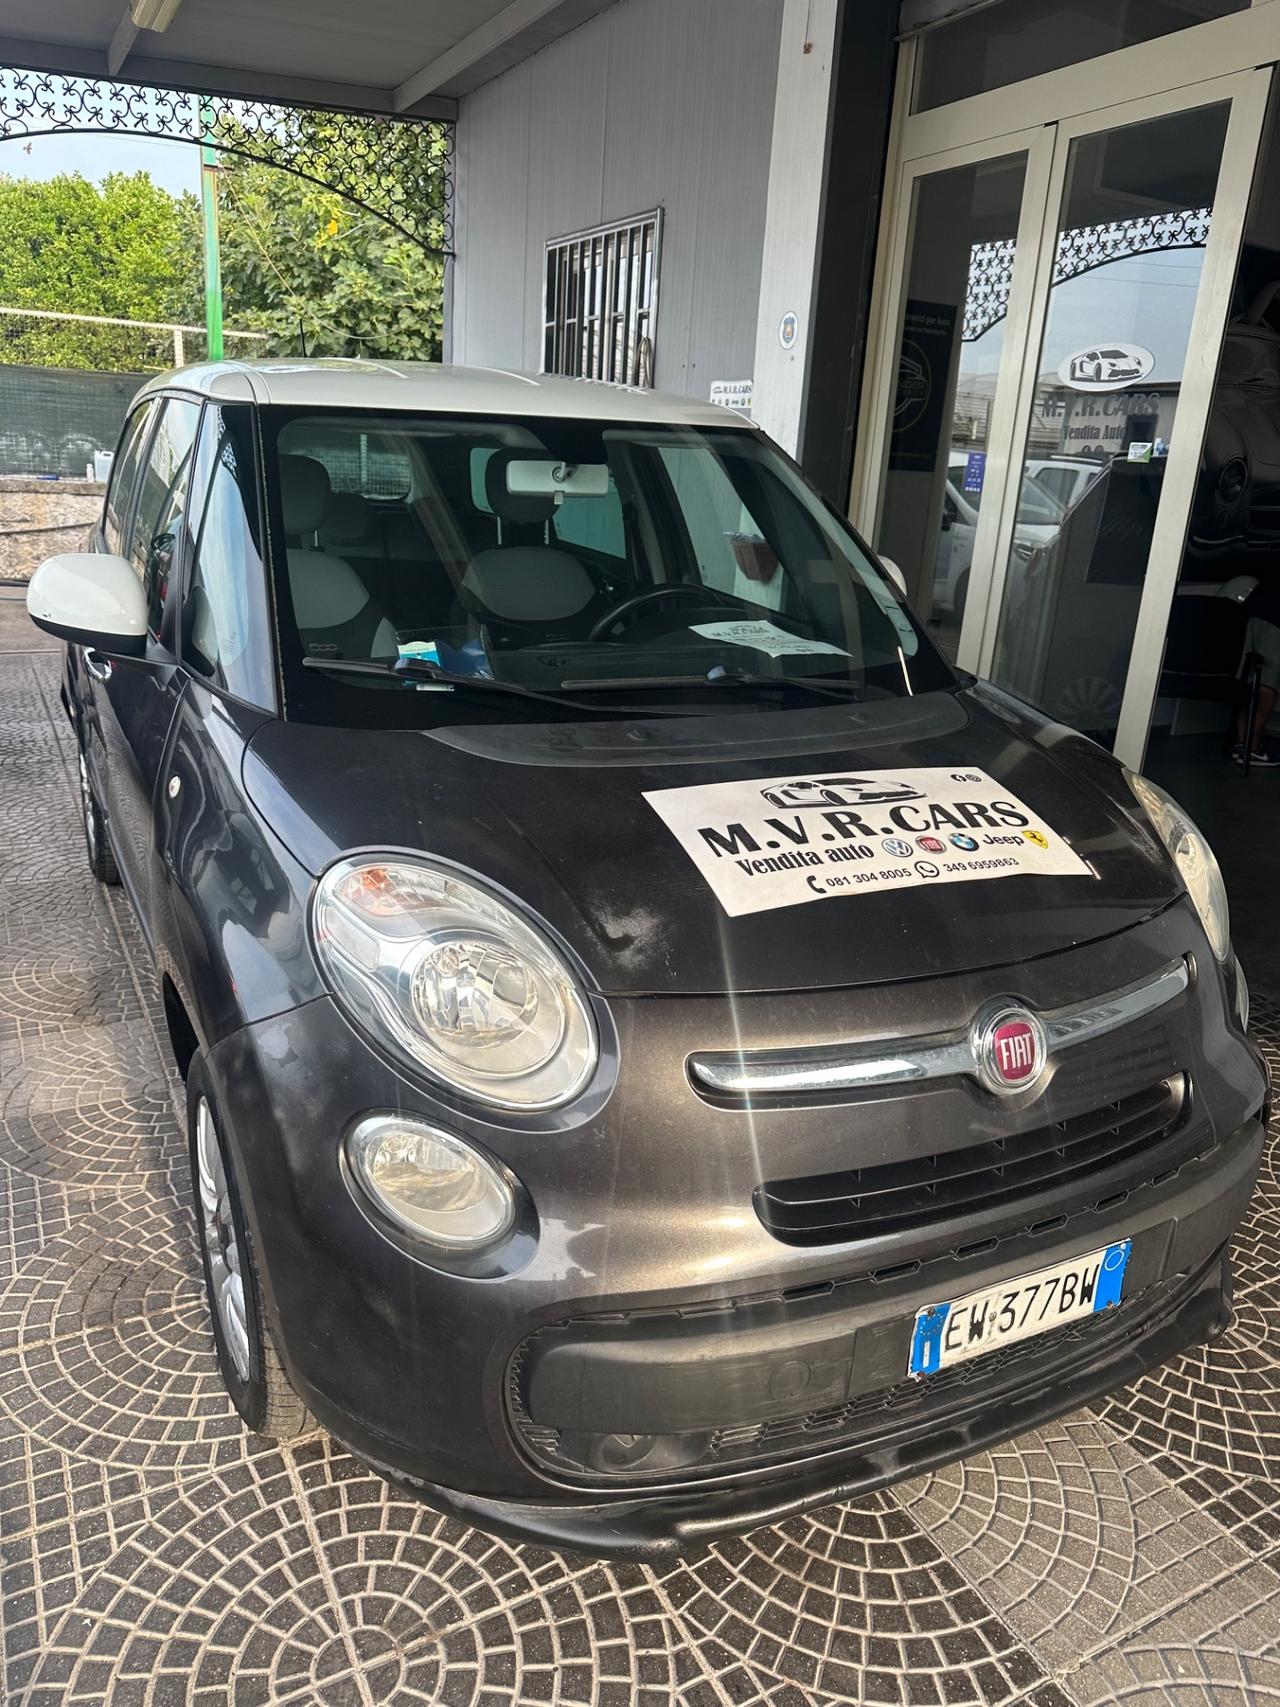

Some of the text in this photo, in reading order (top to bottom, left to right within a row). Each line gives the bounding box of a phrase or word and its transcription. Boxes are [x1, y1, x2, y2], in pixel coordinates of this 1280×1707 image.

[697, 801, 1029, 857] M.V.R.CARS
[982, 832, 1024, 848] Jeep
[735, 842, 875, 877] Vendita auto
[943, 862, 967, 872] 349
[825, 868, 912, 887] 081 304 8005
[1000, 1033, 1031, 1070] FIAT
